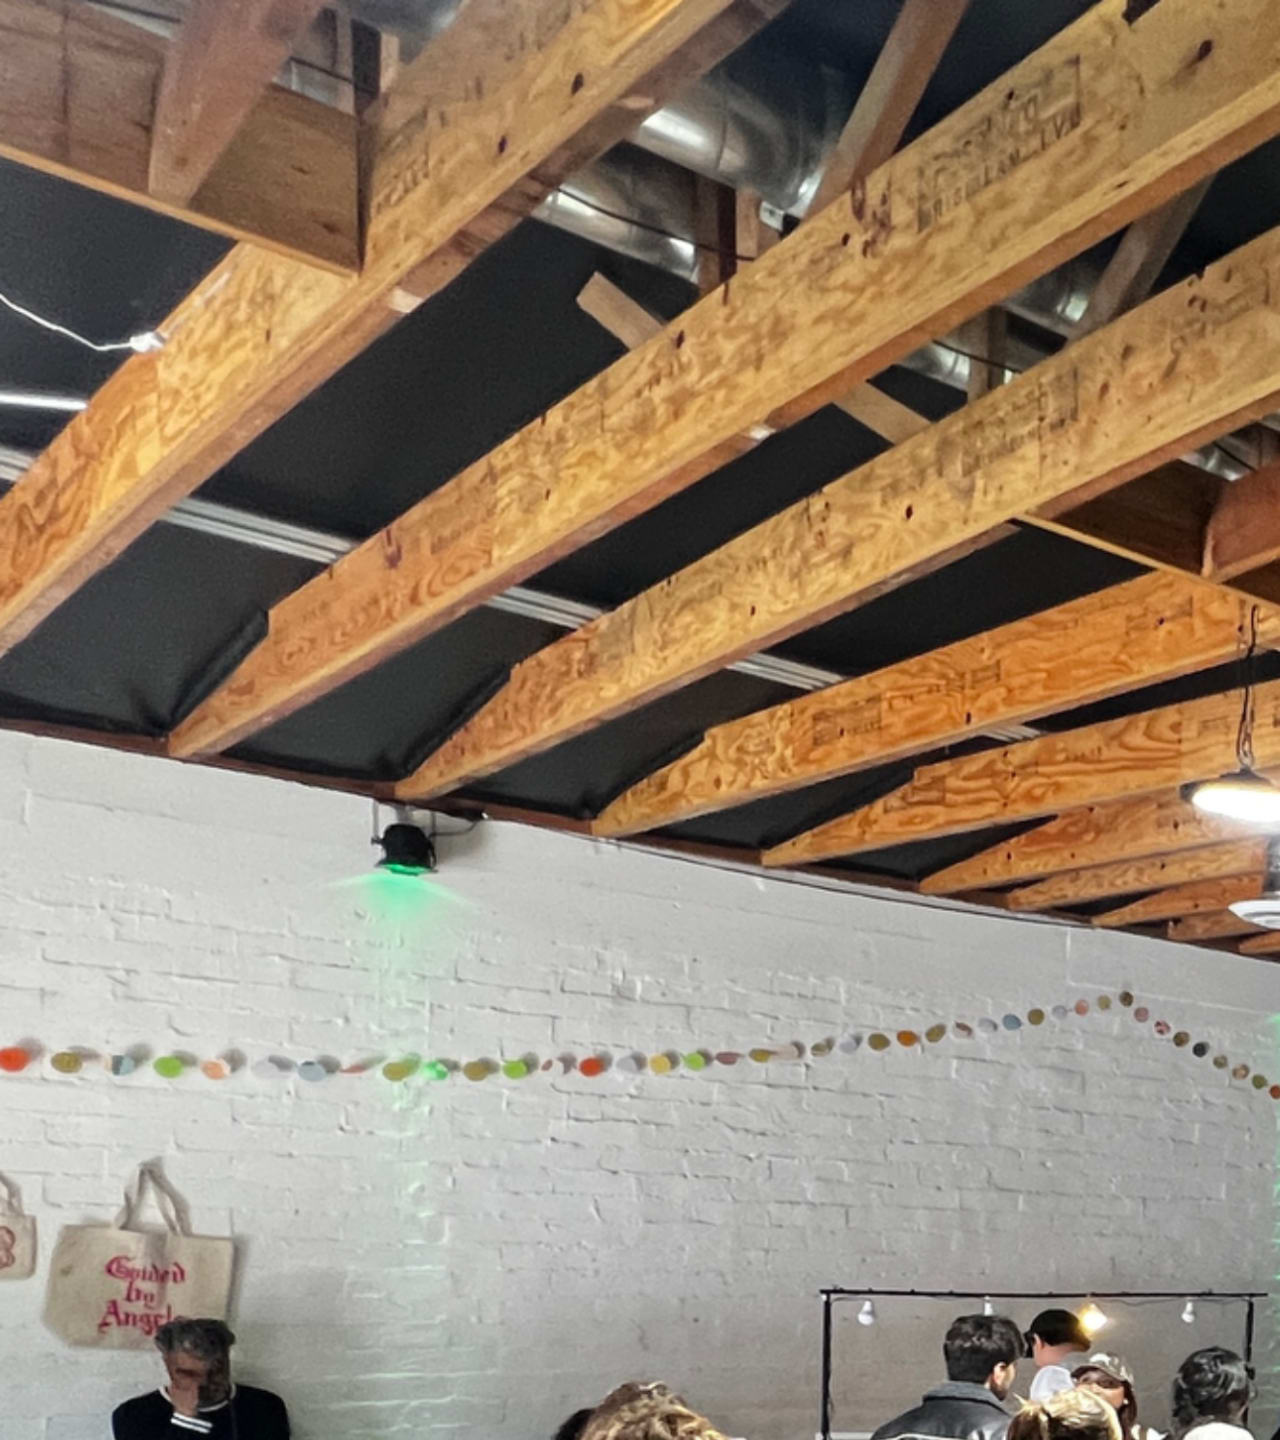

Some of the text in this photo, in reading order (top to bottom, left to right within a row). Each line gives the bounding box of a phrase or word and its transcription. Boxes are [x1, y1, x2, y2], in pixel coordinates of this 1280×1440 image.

[105, 1254, 188, 1284] Guided
[125, 1281, 156, 1309] by
[97, 1300, 188, 1336] Angel
